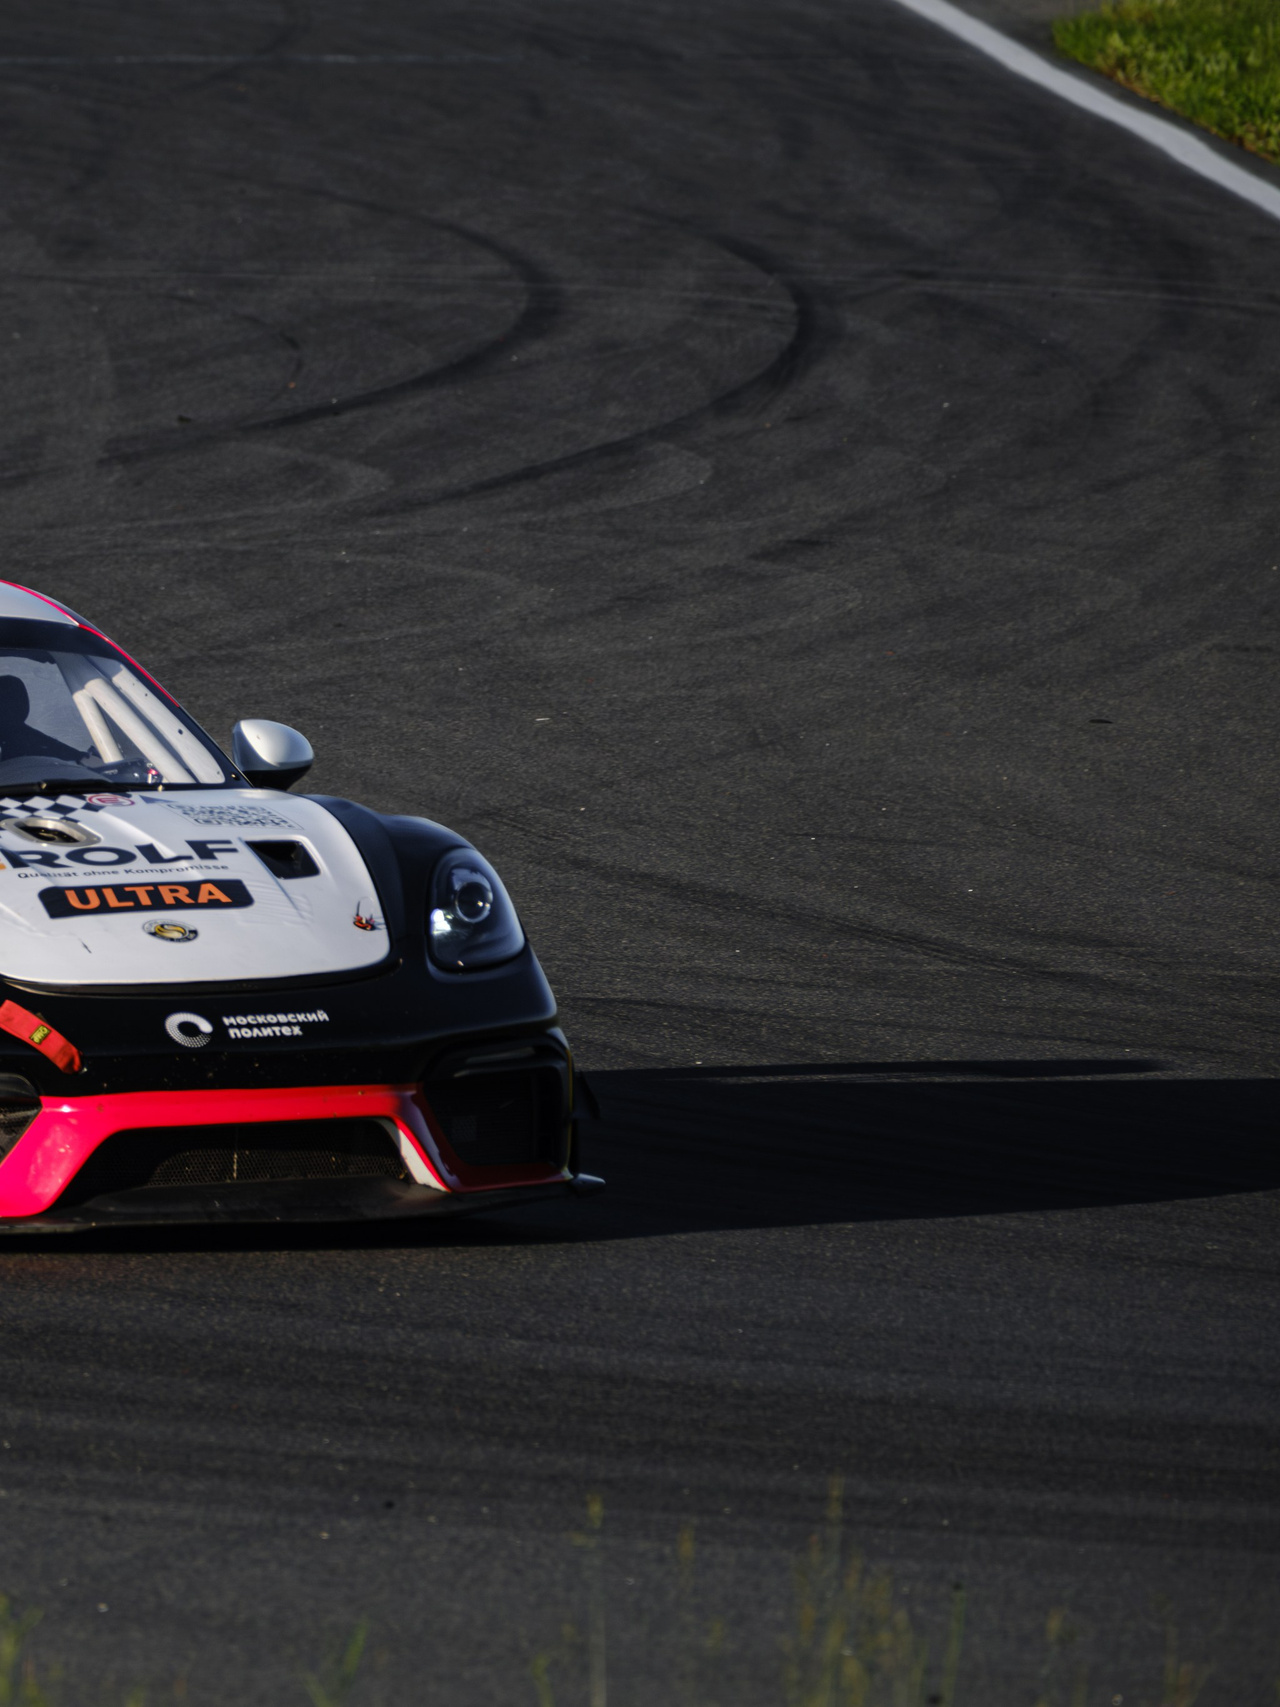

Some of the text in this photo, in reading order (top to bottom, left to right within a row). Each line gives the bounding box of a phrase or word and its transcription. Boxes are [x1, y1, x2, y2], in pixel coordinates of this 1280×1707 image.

[17, 864, 229, 879] Qualität ohne Kompromisse
[64, 883, 233, 910] ULTRA
